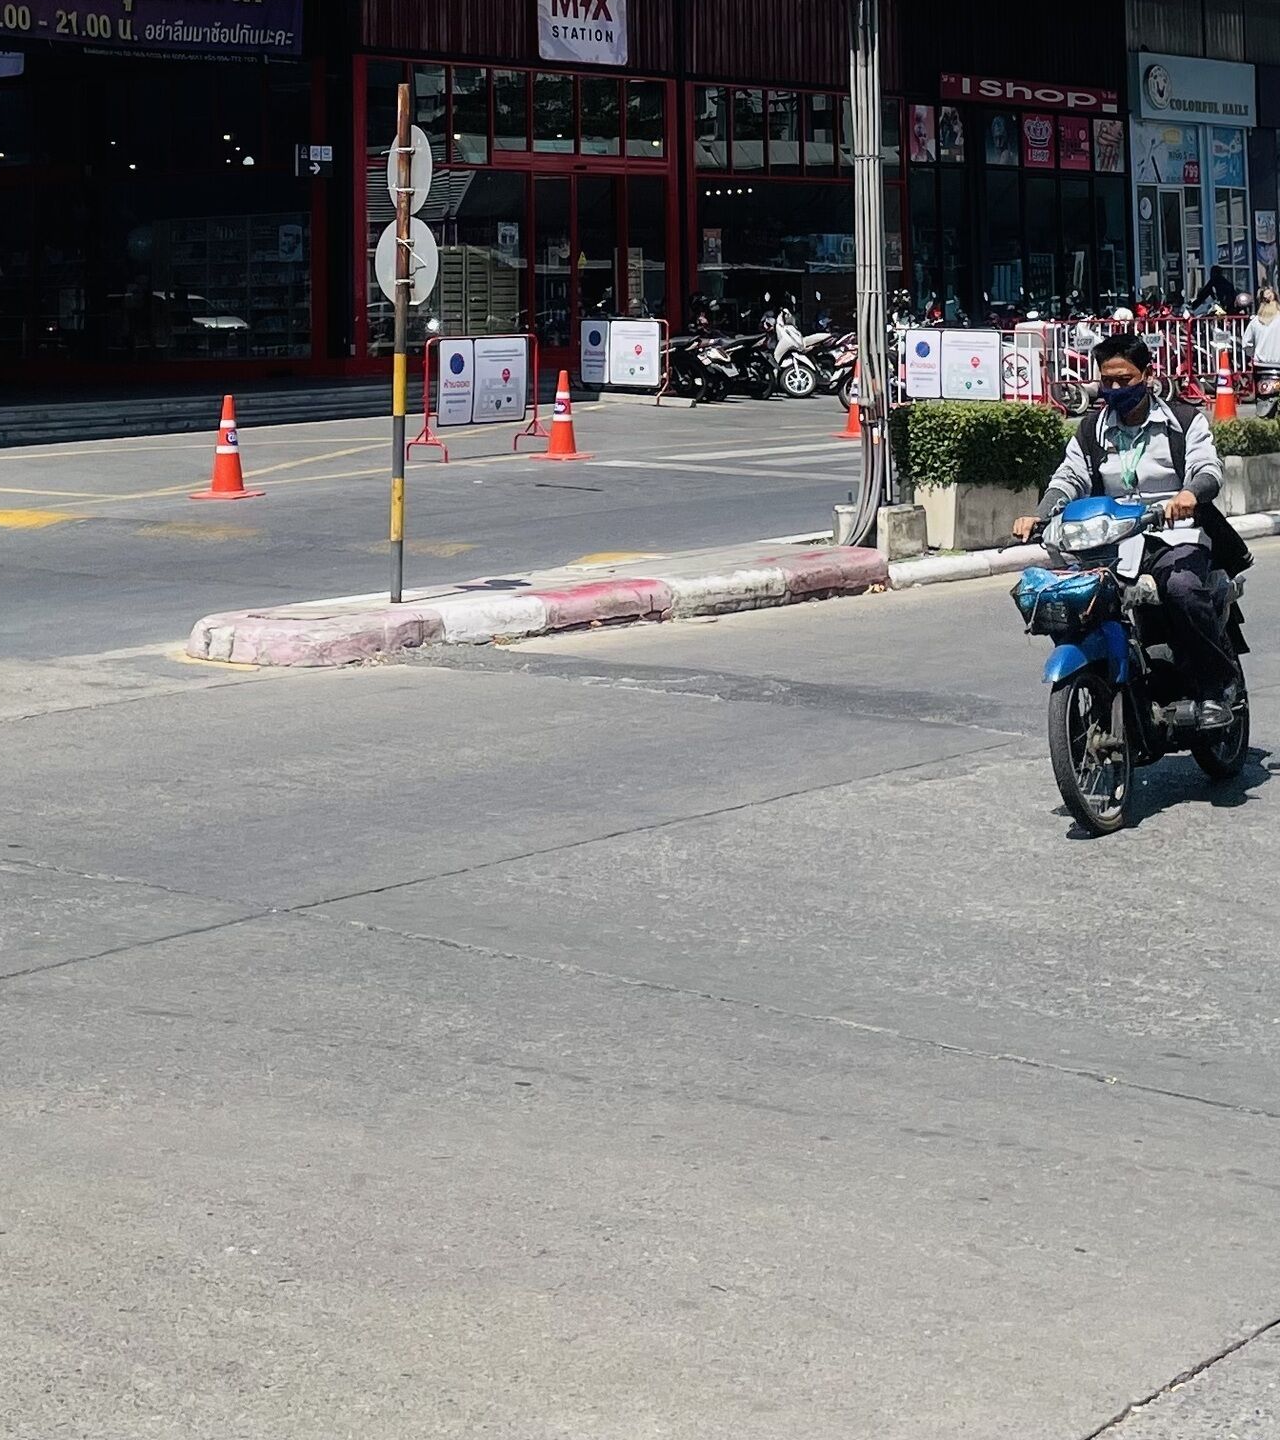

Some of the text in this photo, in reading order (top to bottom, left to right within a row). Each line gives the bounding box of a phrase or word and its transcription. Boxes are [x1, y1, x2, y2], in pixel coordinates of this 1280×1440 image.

[56, 10, 111, 38] 21.00
[552, 25, 613, 43] STATION
[978, 79, 1098, 108] Shop
[1169, 99, 1220, 114] COLORFUL
